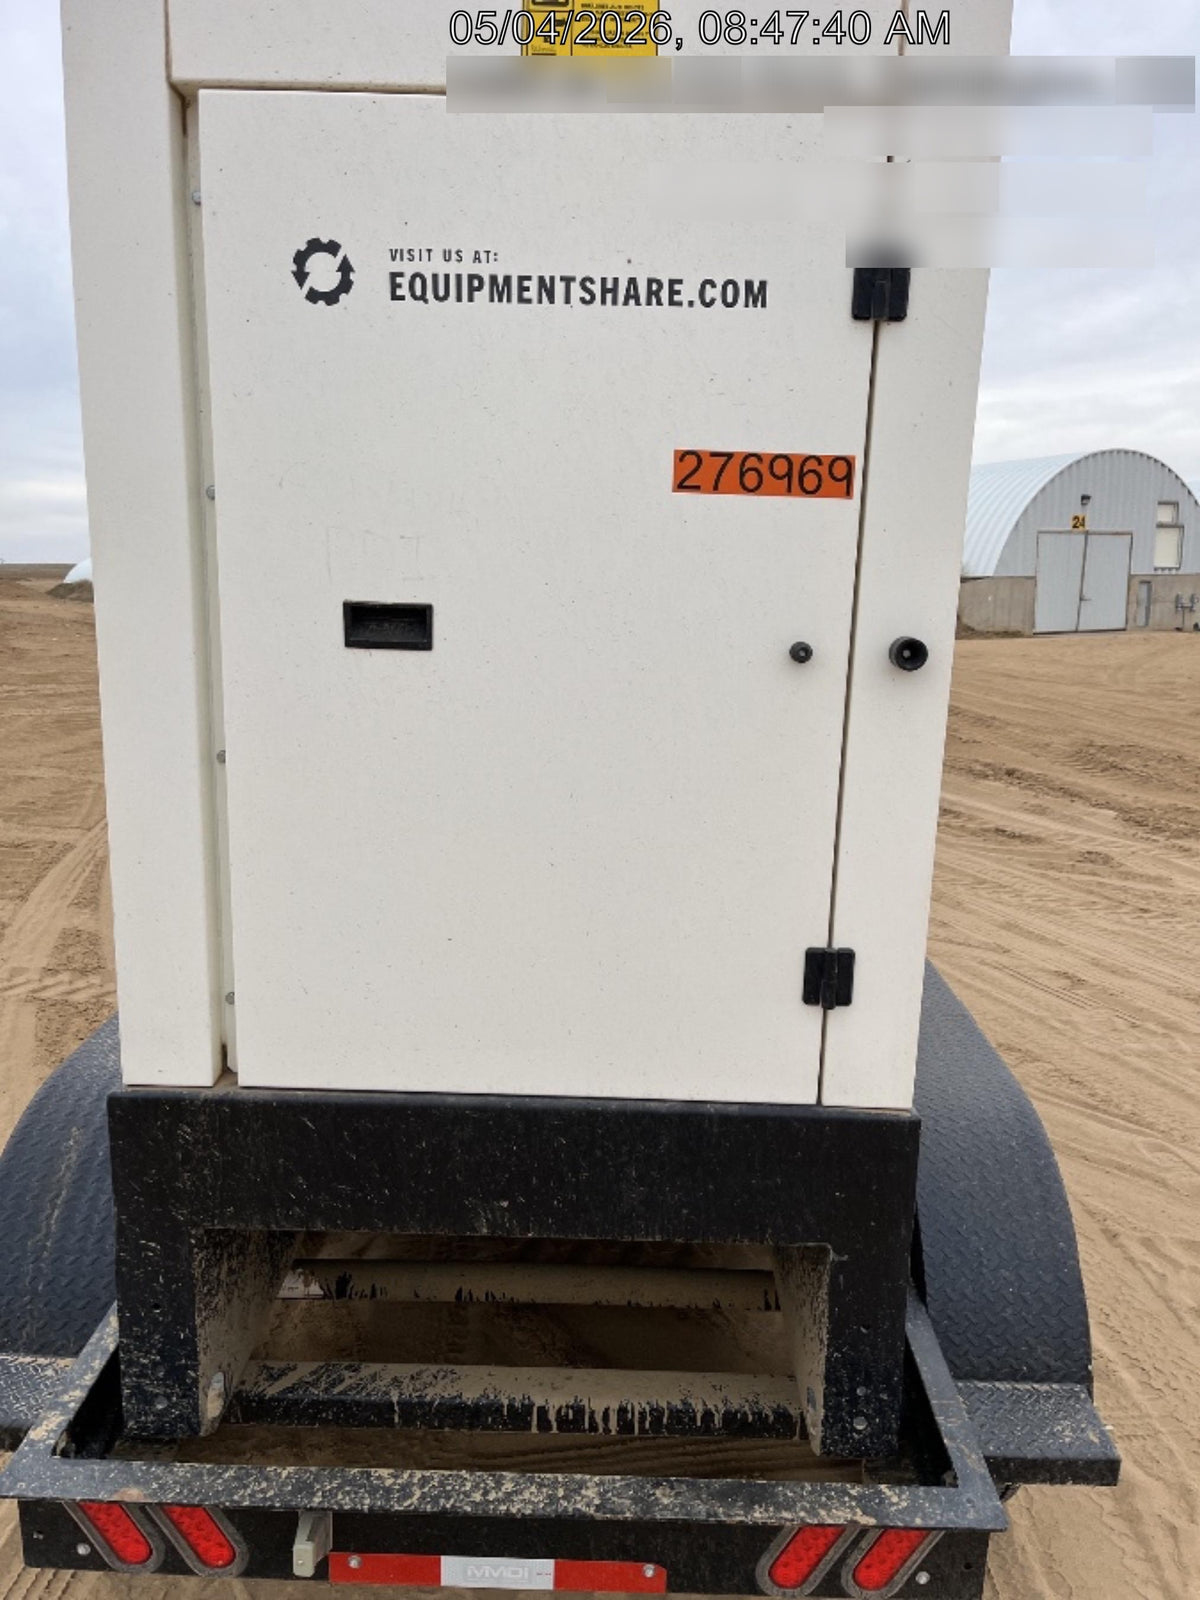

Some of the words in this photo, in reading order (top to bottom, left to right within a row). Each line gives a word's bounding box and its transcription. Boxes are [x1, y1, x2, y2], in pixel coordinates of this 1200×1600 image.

[389, 248, 433, 263] VISIT
[442, 249, 464, 263] US
[472, 251, 499, 264] AT:
[389, 271, 768, 308] EQUIPMENTSHARE.COM
[677, 450, 852, 496] 276969
[1072, 515, 1085, 528] 24
